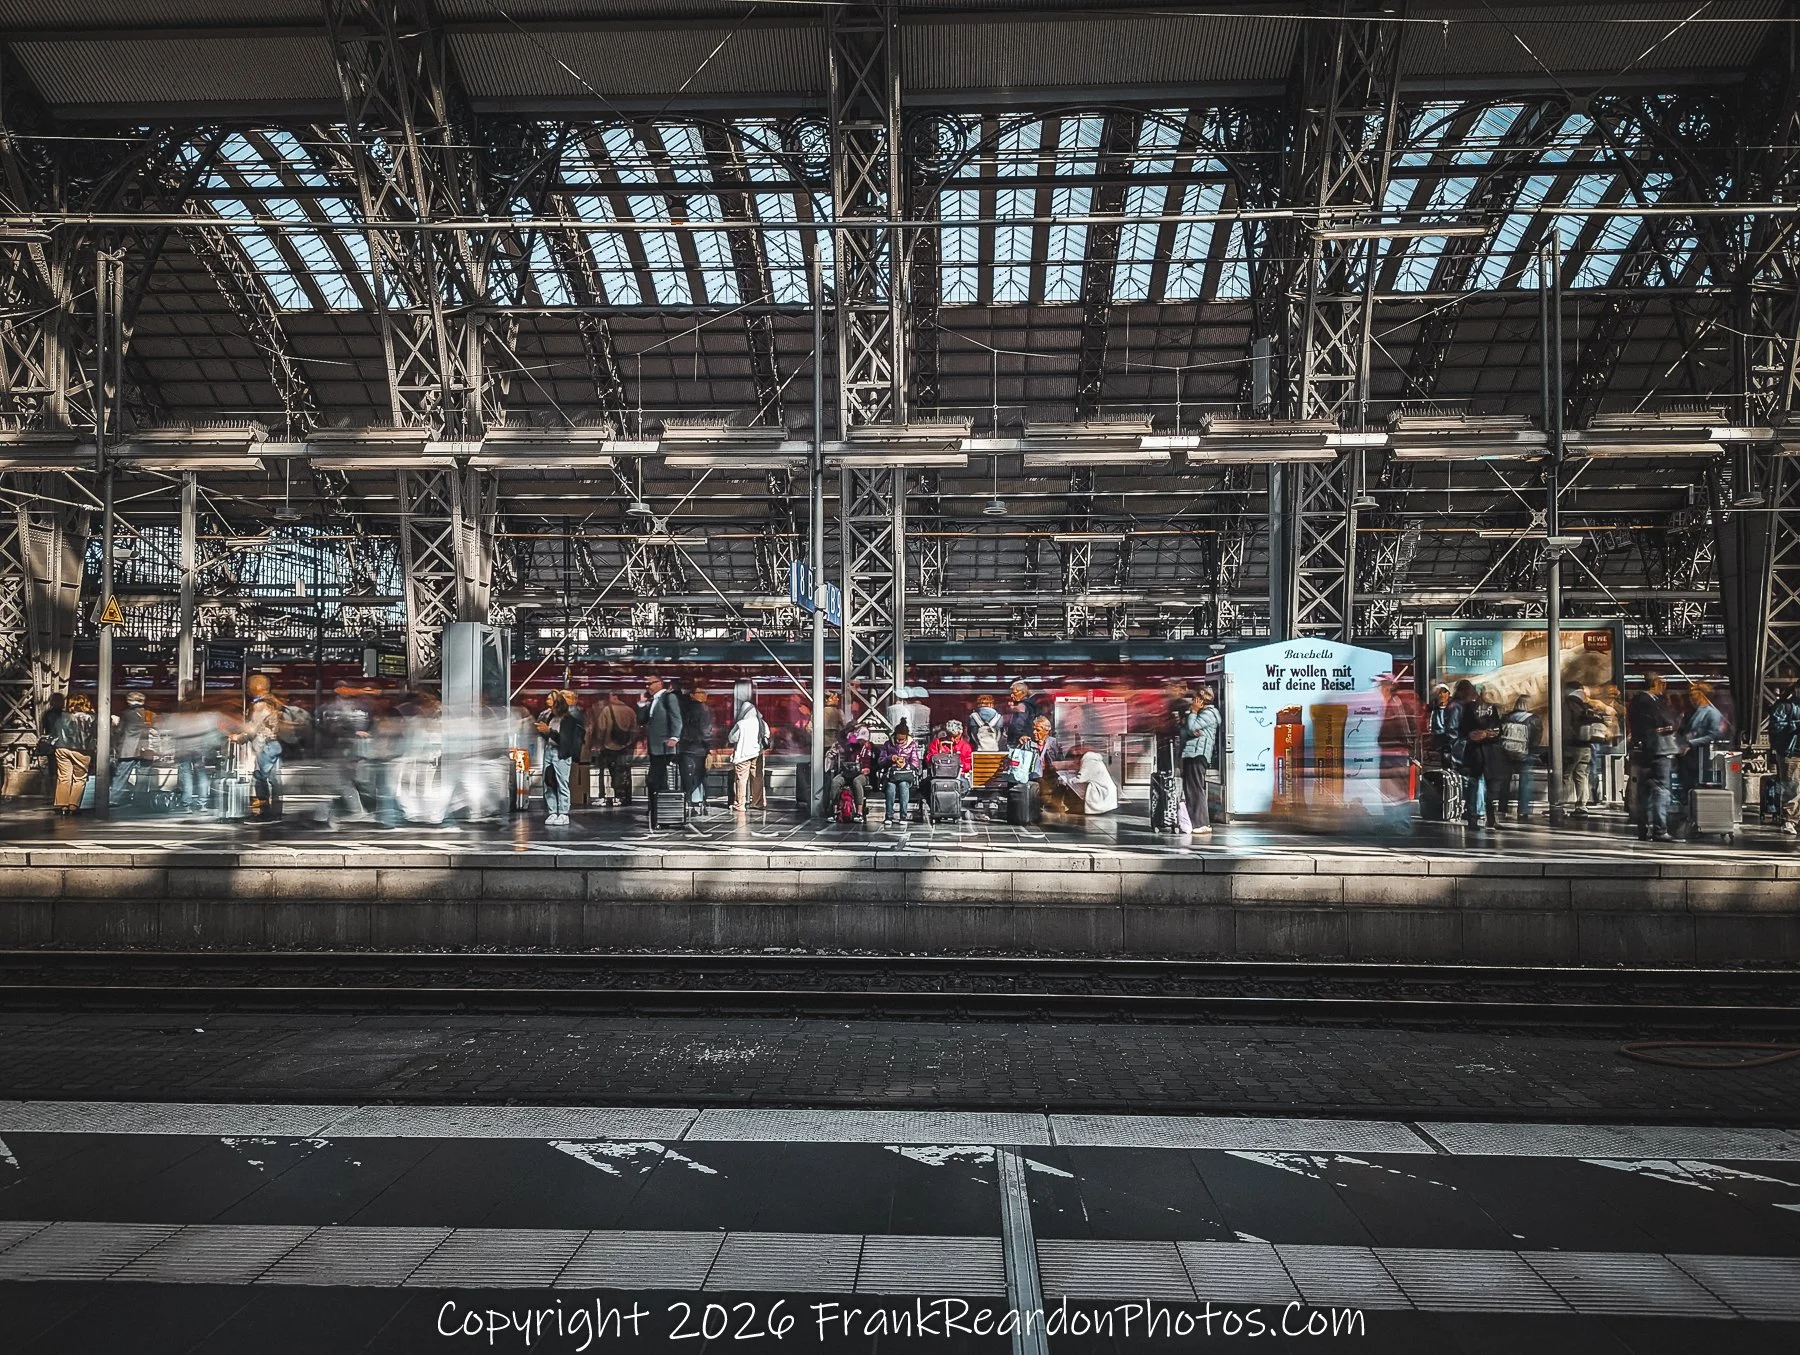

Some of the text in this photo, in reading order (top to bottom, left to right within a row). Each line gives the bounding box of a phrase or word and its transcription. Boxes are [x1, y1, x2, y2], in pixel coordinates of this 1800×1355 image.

[800, 564, 805, 596] 8
[831, 587, 836, 614] B
[1459, 636, 1493, 646] Frische
[1284, 649, 1333, 659] Barebells
[1451, 647, 1491, 657] hat einen
[1465, 658, 1496, 667] Namen
[1265, 664, 1352, 677] Wir wollen mit
[1262, 678, 1355, 691] auf deine Reise!
